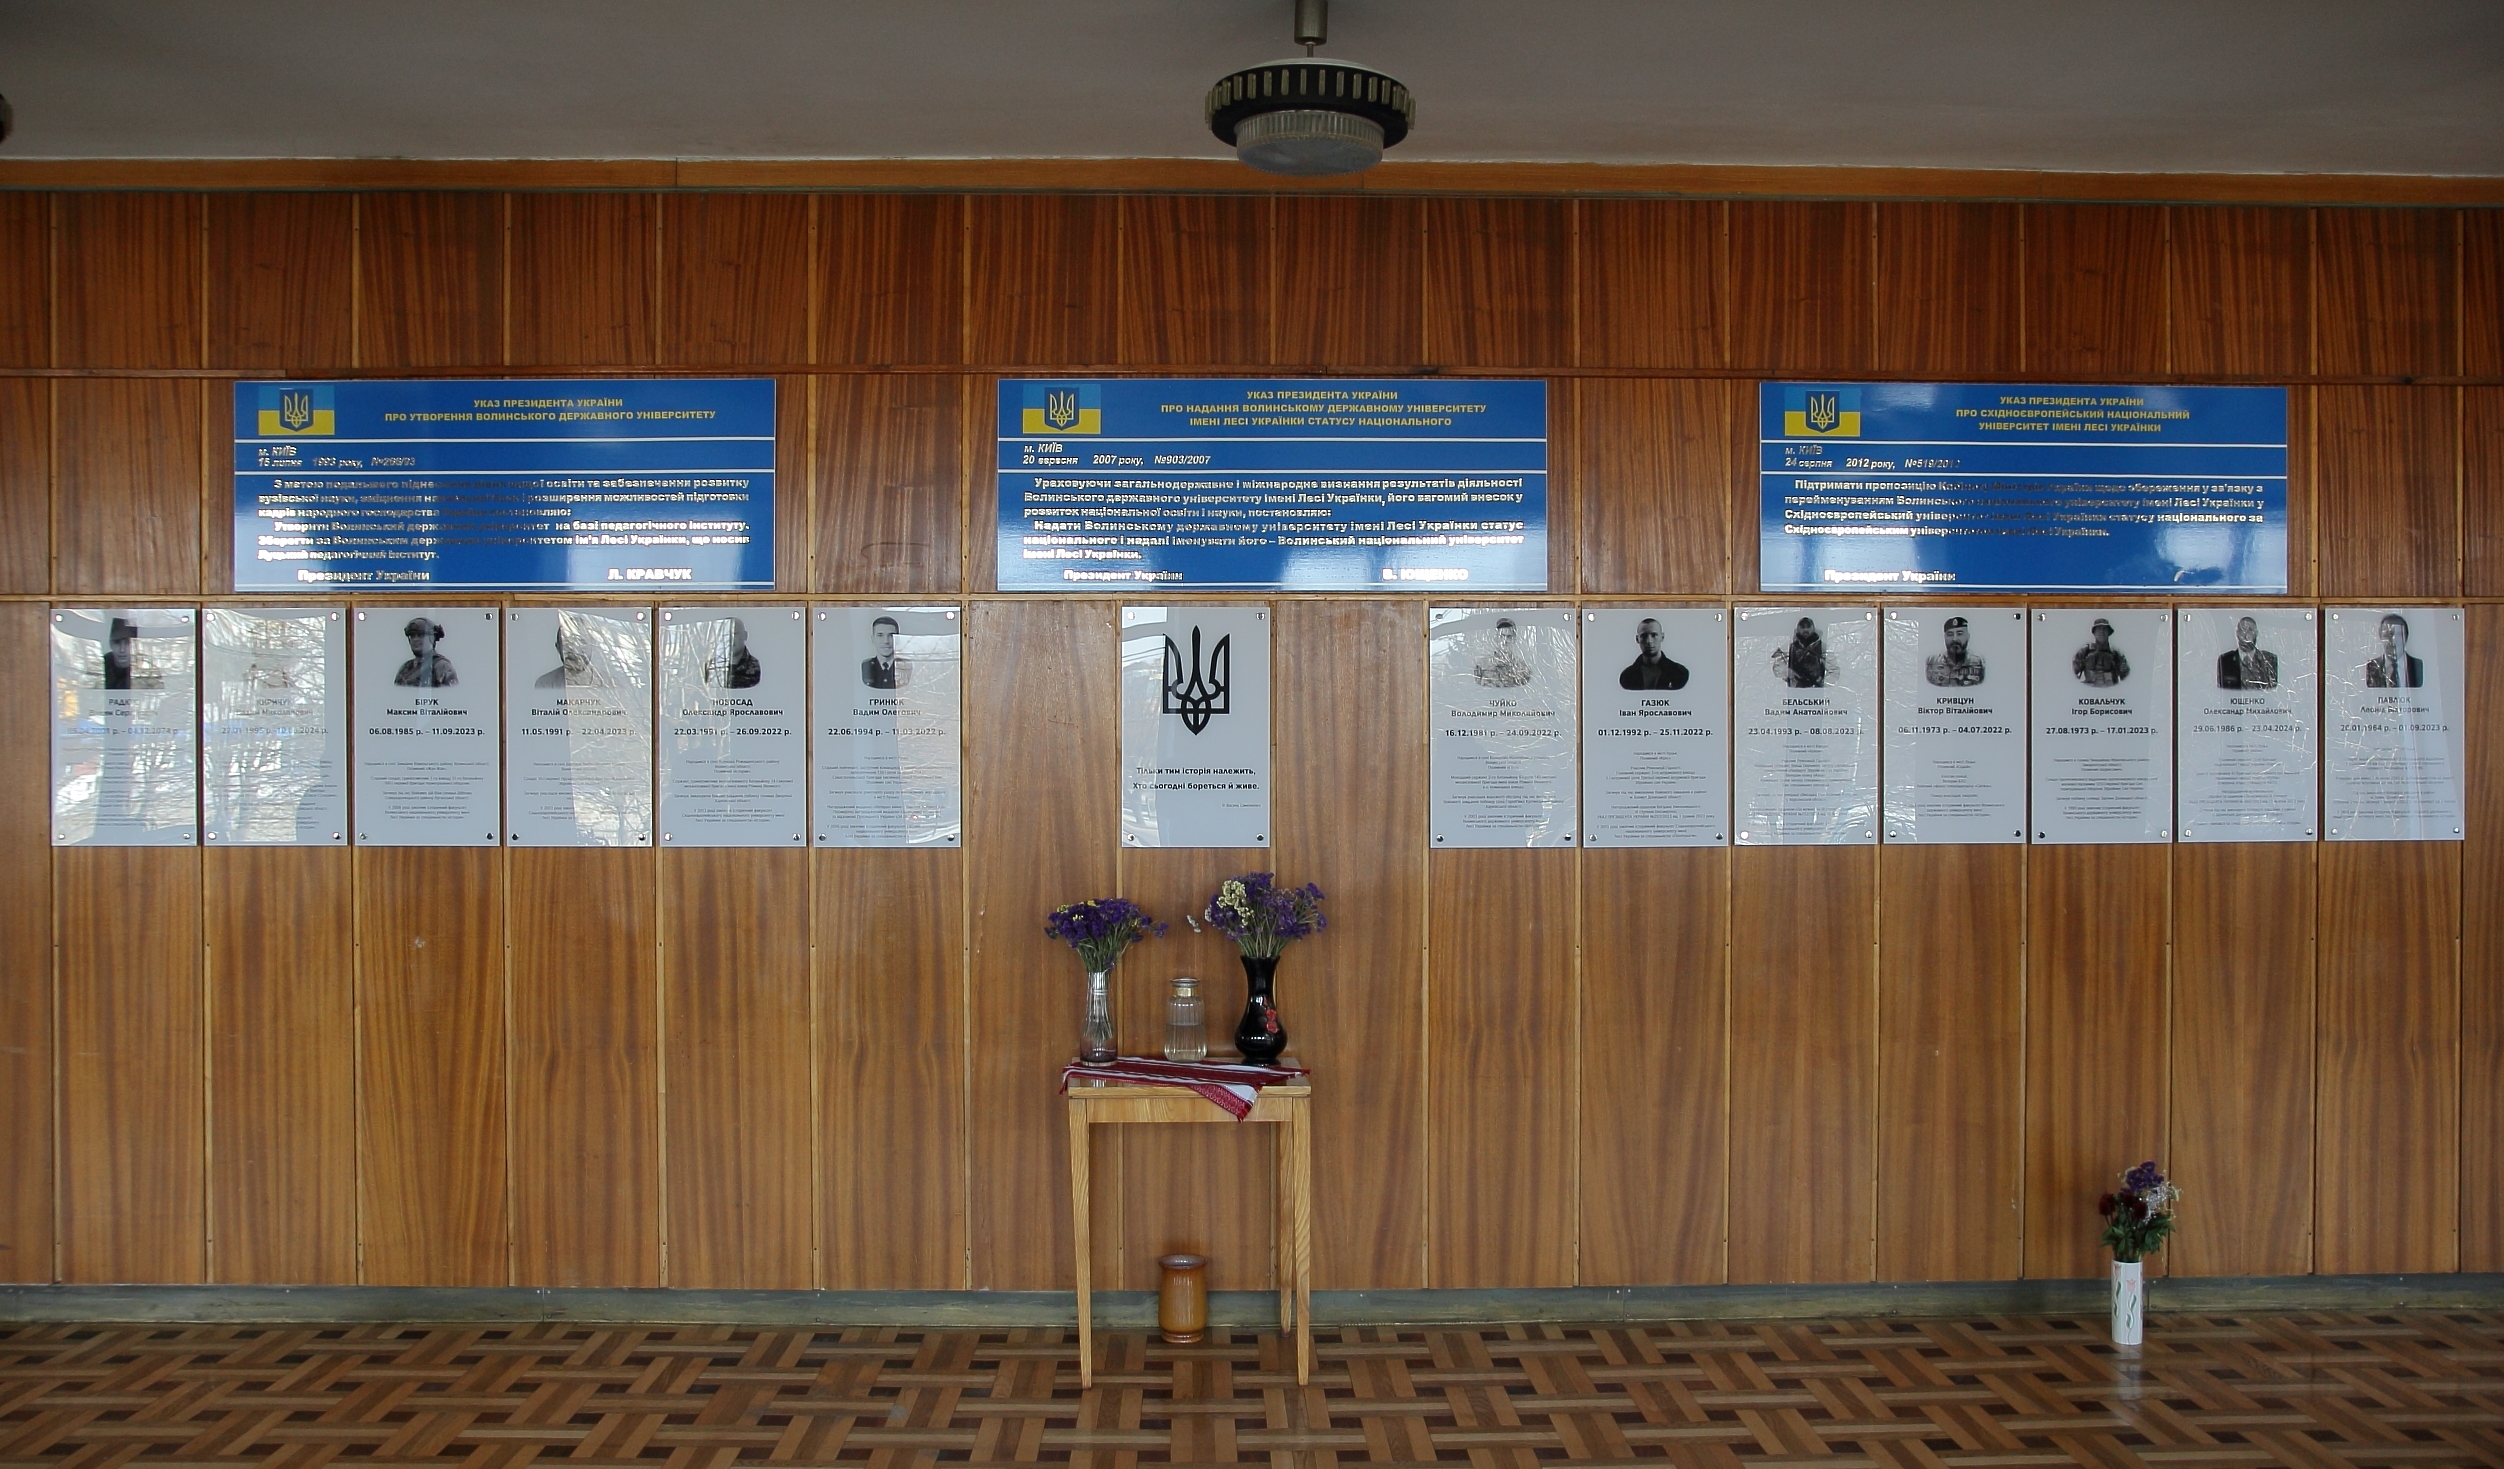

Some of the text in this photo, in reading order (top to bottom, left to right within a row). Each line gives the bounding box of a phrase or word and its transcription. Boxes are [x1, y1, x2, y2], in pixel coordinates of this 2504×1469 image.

[1246, 390, 1398, 401] УКАЗ ПРЕЗИДЕНТА УКРАЇНИ
[473, 398, 623, 409] УКАЗ ПРЕЗИДЕНТА УКРАЇНИ
[2000, 396, 2144, 406] УКАЗ ПРЕЗИДЕНТА УКРАЇНИ
[1161, 404, 1487, 414] ПРО НАДАННЯ ВОЛИНСЬКОМУ ДЕРЖАВНОМУ УНІВЕРСИТЕТУ
[385, 411, 716, 422] ПРО УТВОРЕННЯ ВОЛИНСЬКОГО ДЕРЖАВНОГО УНІВЕРСИТЕТУ
[1956, 409, 2190, 420] ПРО СХІДНОЄВРОПЕЙСЬКИЙ НАЦІОНАЛЬНИЙ
[1190, 416, 1452, 427] ІМЕНІ ЛЕСІ УКРАЇНКИ СТАТУСУ НАЦІОНАЛЬНОГО
[1979, 422, 2161, 432] УНІВЕРСИТЕТ ІМЕНІ ЛЕСІ УКРАЇНКИ
[271, 445, 297, 457] КИЇВ
[1024, 443, 1063, 453] м. КИЇВ
[1785, 445, 1822, 455] м. КИЇВ
[1023, 455, 1211, 467] 20 вересня 2007 року, №903/2007
[1785, 458, 1797, 467] 24
[1798, 460, 1833, 469] серпня
[1846, 458, 1869, 468] 2012
[1870, 460, 1896, 470] року,
[546, 479, 585, 488] освіти
[587, 480, 600, 488] та
[602, 479, 691, 488] забезпечення
[693, 479, 749, 489] розвитку
[1034, 478, 1112, 489] Ураховуючи
[1242, 479, 1318, 490] міжнародне
[1320, 480, 1381, 489] визнання
[1382, 479, 1455, 489] результатів
[1457, 478, 1522, 489] діяльності
[1794, 479, 1863, 491] Підтримати
[1865, 481, 1936, 491] пропозицію
[1024, 493, 1523, 506] Волинського державного університету імені Лесі Українки, його вагомий внесок у
[1785, 509, 1913, 522] Східноєвропейський
[2157, 513, 2263, 523] національного за
[572, 520, 749, 533] базі педагогічного інституту.
[298, 570, 430, 582] Президент України
[608, 568, 691, 580] Л. КРАВЧУК
[1064, 570, 1183, 582] Президент України
[1382, 568, 1468, 582] В. ЮЩЕНКО
[1824, 570, 1956, 584] Президент України
[1489, 699, 1517, 707] ЧУЙКО
[1641, 699, 1670, 707] ГАЗЮК
[1782, 698, 1830, 706] БЕЛЬСЬКИЙ
[1936, 697, 1974, 706] КРИВЦУН
[2078, 698, 2125, 706] КОВАЛЬЧУК
[2230, 697, 2265, 706] ЮЩЕНКО
[386, 708, 468, 716] Максим Віталійович
[531, 708, 560, 716] Віталій
[682, 708, 784, 718] Олександр Ярославович
[853, 708, 921, 717] Вадим Олегович
[1451, 709, 1555, 718] Володимир Миколайович
[1619, 709, 1692, 717] Іван Ярославович
[1764, 707, 1848, 717] Вадим Анатолійович
[1918, 707, 1993, 715] Віктор Віталійович
[2071, 707, 2132, 716] Ігор Борисович
[2204, 707, 2292, 716] Олександр Михайлович
[2360, 706, 2385, 714] Леонід
[369, 728, 475, 736] 06.08.1985 11.09.2023
[521, 728, 563, 736] 11.05.1991
[828, 728, 873, 736] 22.06.1994
[1445, 729, 1552, 737] 16.12.1981 24.09.2022
[1748, 727, 1854, 735] 23.04.1993 08.08.2023
[1898, 726, 2000, 734] 06.11.1973 04.07.2022
[2046, 727, 2149, 735] 27.08.1973 17.01.2023
[2193, 725, 2293, 733] 29.06.1986 23.04.2024
[2399, 724, 2440, 732] 01.09.2023
[1136, 767, 1163, 775] Тільки
[1182, 767, 1211, 777] історія
[1213, 768, 1256, 776] належить,
[1150, 782, 1185, 791] сьогодні
[1188, 782, 1226, 791] бореться
[1228, 781, 1234, 789] й
